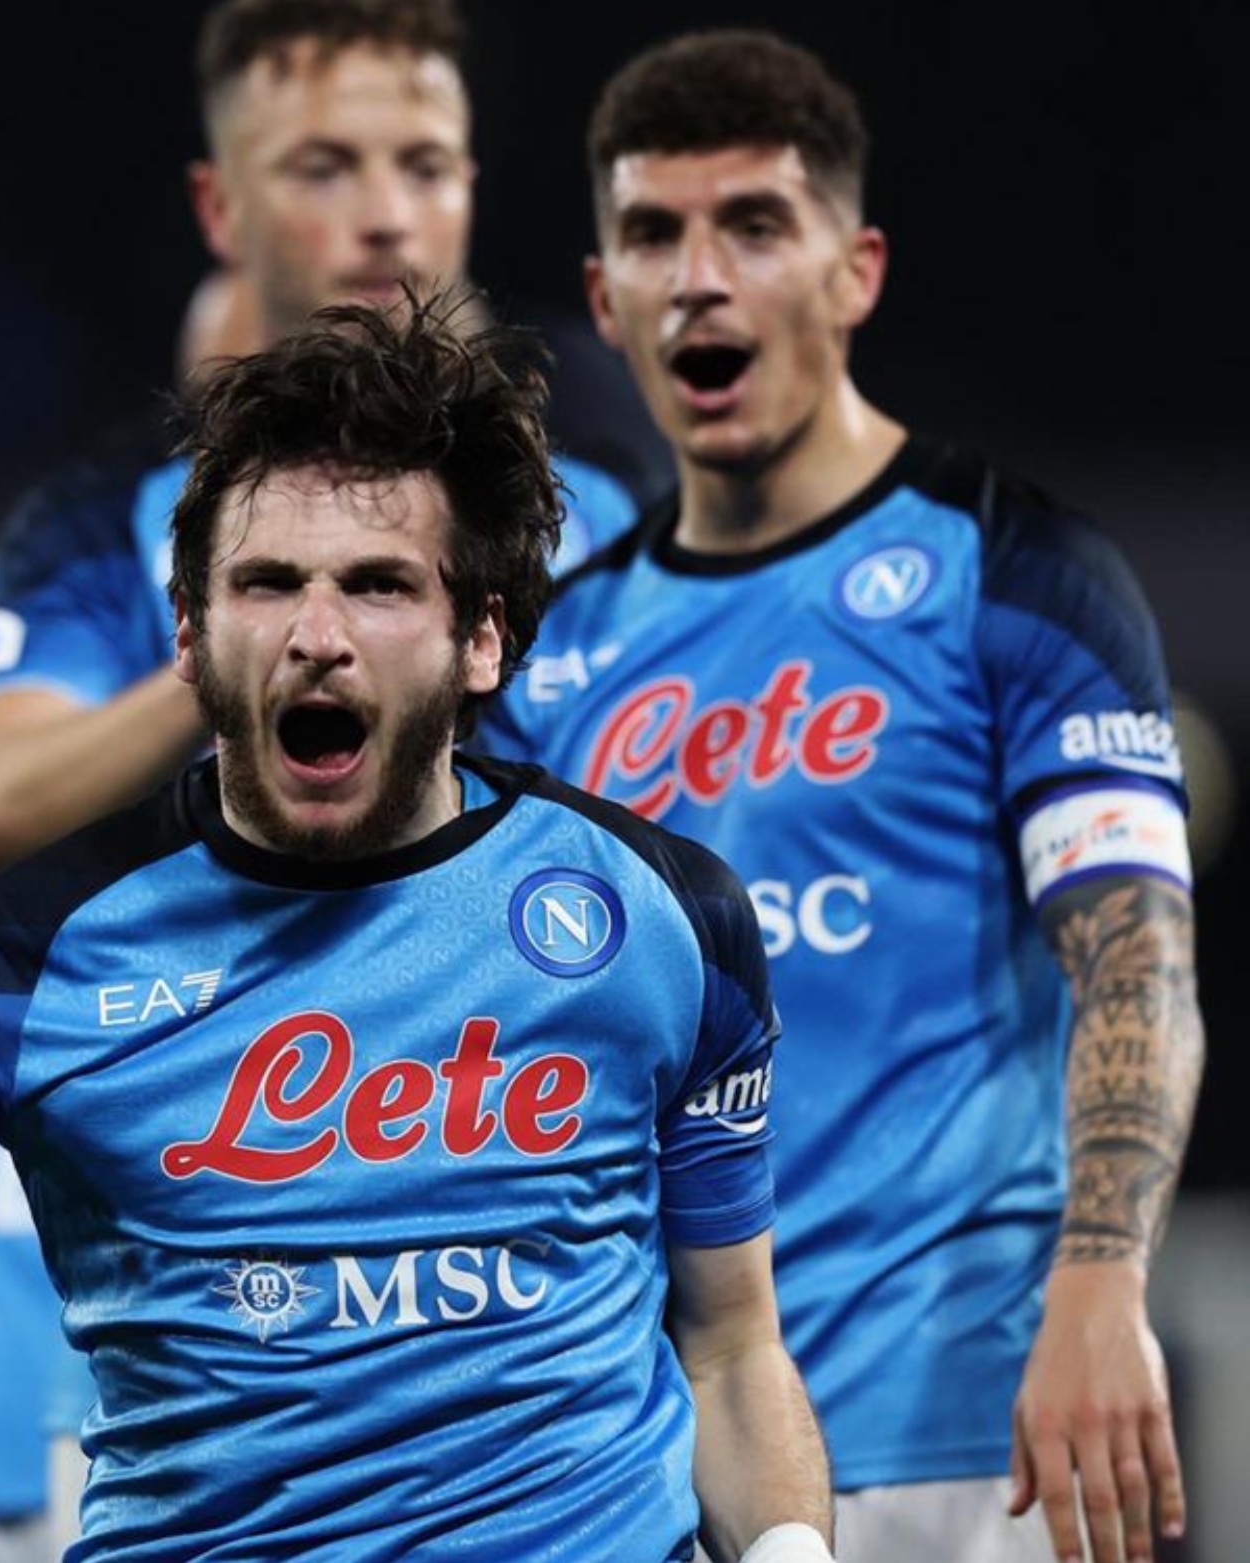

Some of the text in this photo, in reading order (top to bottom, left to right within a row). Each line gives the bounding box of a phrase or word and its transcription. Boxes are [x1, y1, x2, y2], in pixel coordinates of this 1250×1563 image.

[582, 659, 887, 822] Lete
[539, 898, 589, 947] N
[98, 967, 223, 1028] EA7
[160, 1009, 589, 1185] Lete
[329, 1239, 550, 1328] MSC
